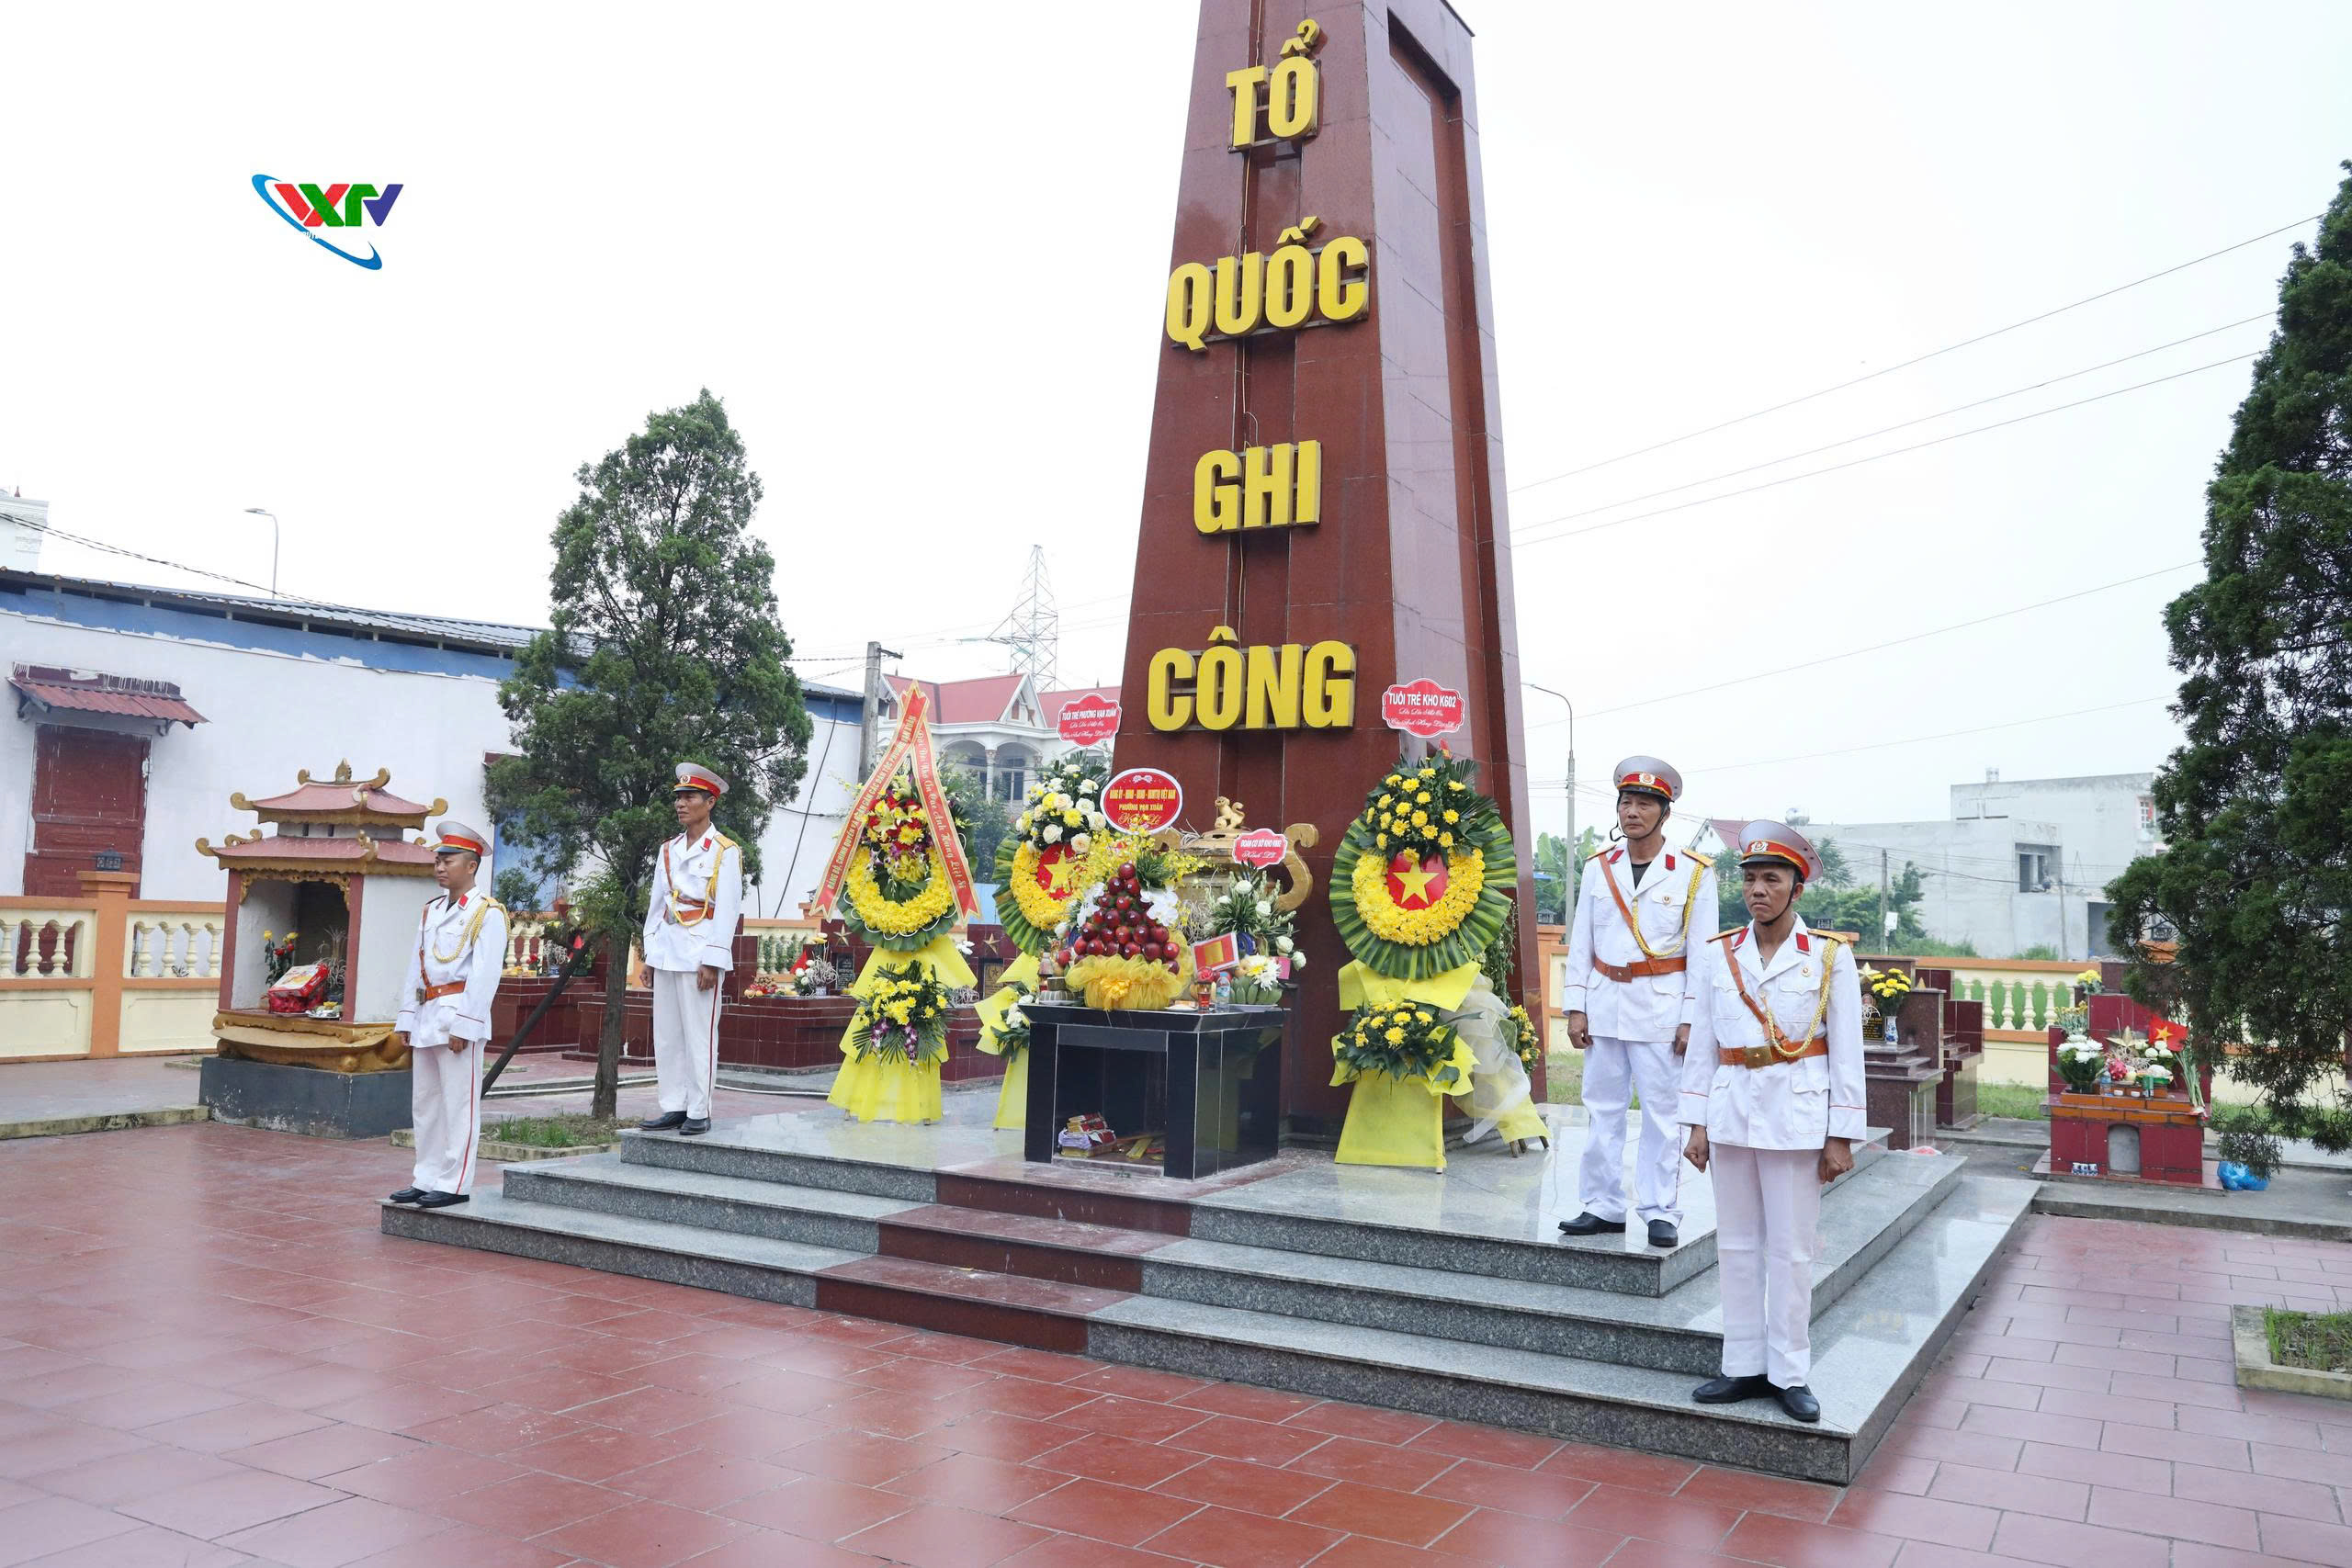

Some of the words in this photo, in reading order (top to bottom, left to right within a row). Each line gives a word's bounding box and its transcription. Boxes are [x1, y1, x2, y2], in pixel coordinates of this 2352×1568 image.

[1226, 18, 1320, 149] TỔ
[1166, 216, 1369, 352] QUỐC
[1194, 439, 1321, 535] GHI
[1148, 626, 1356, 732] CÔNG
[1389, 691, 1406, 705] TUỔI
[1408, 691, 1421, 705] TRẺ
[1422, 694, 1439, 706] KHO
[1440, 695, 1456, 708] K602
